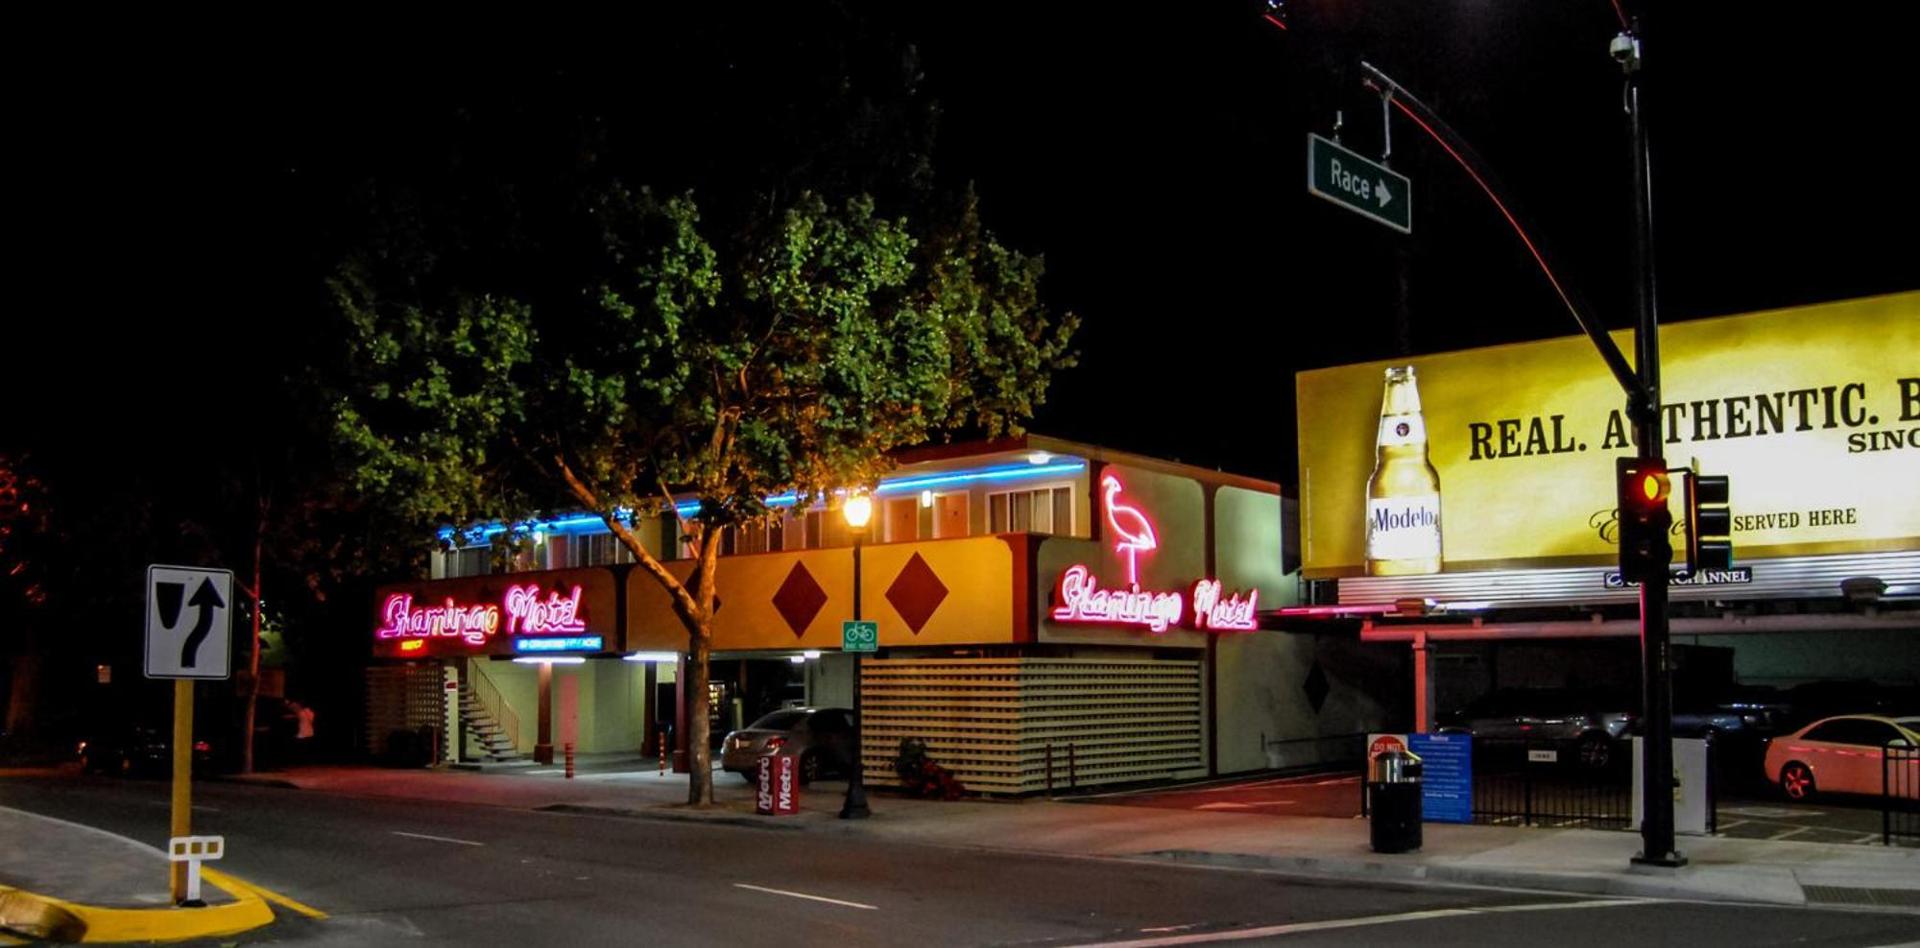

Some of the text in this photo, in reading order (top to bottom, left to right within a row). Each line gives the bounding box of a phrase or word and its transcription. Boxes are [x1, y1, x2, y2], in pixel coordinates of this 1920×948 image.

[1330, 158, 1370, 200] Race
[1468, 413, 1588, 461] REAL.
[1601, 382, 1880, 450] ATHENTIC.
[1374, 506, 1434, 532] Modelo
[1734, 508, 1857, 532] SERVED HERE
[377, 583, 586, 645] Flamingo Motel
[1053, 564, 1259, 633] Flamingo Motel
[1374, 743, 1401, 752] DO NOT
[758, 757, 771, 810] Metro
[779, 756, 792, 810] Metro
